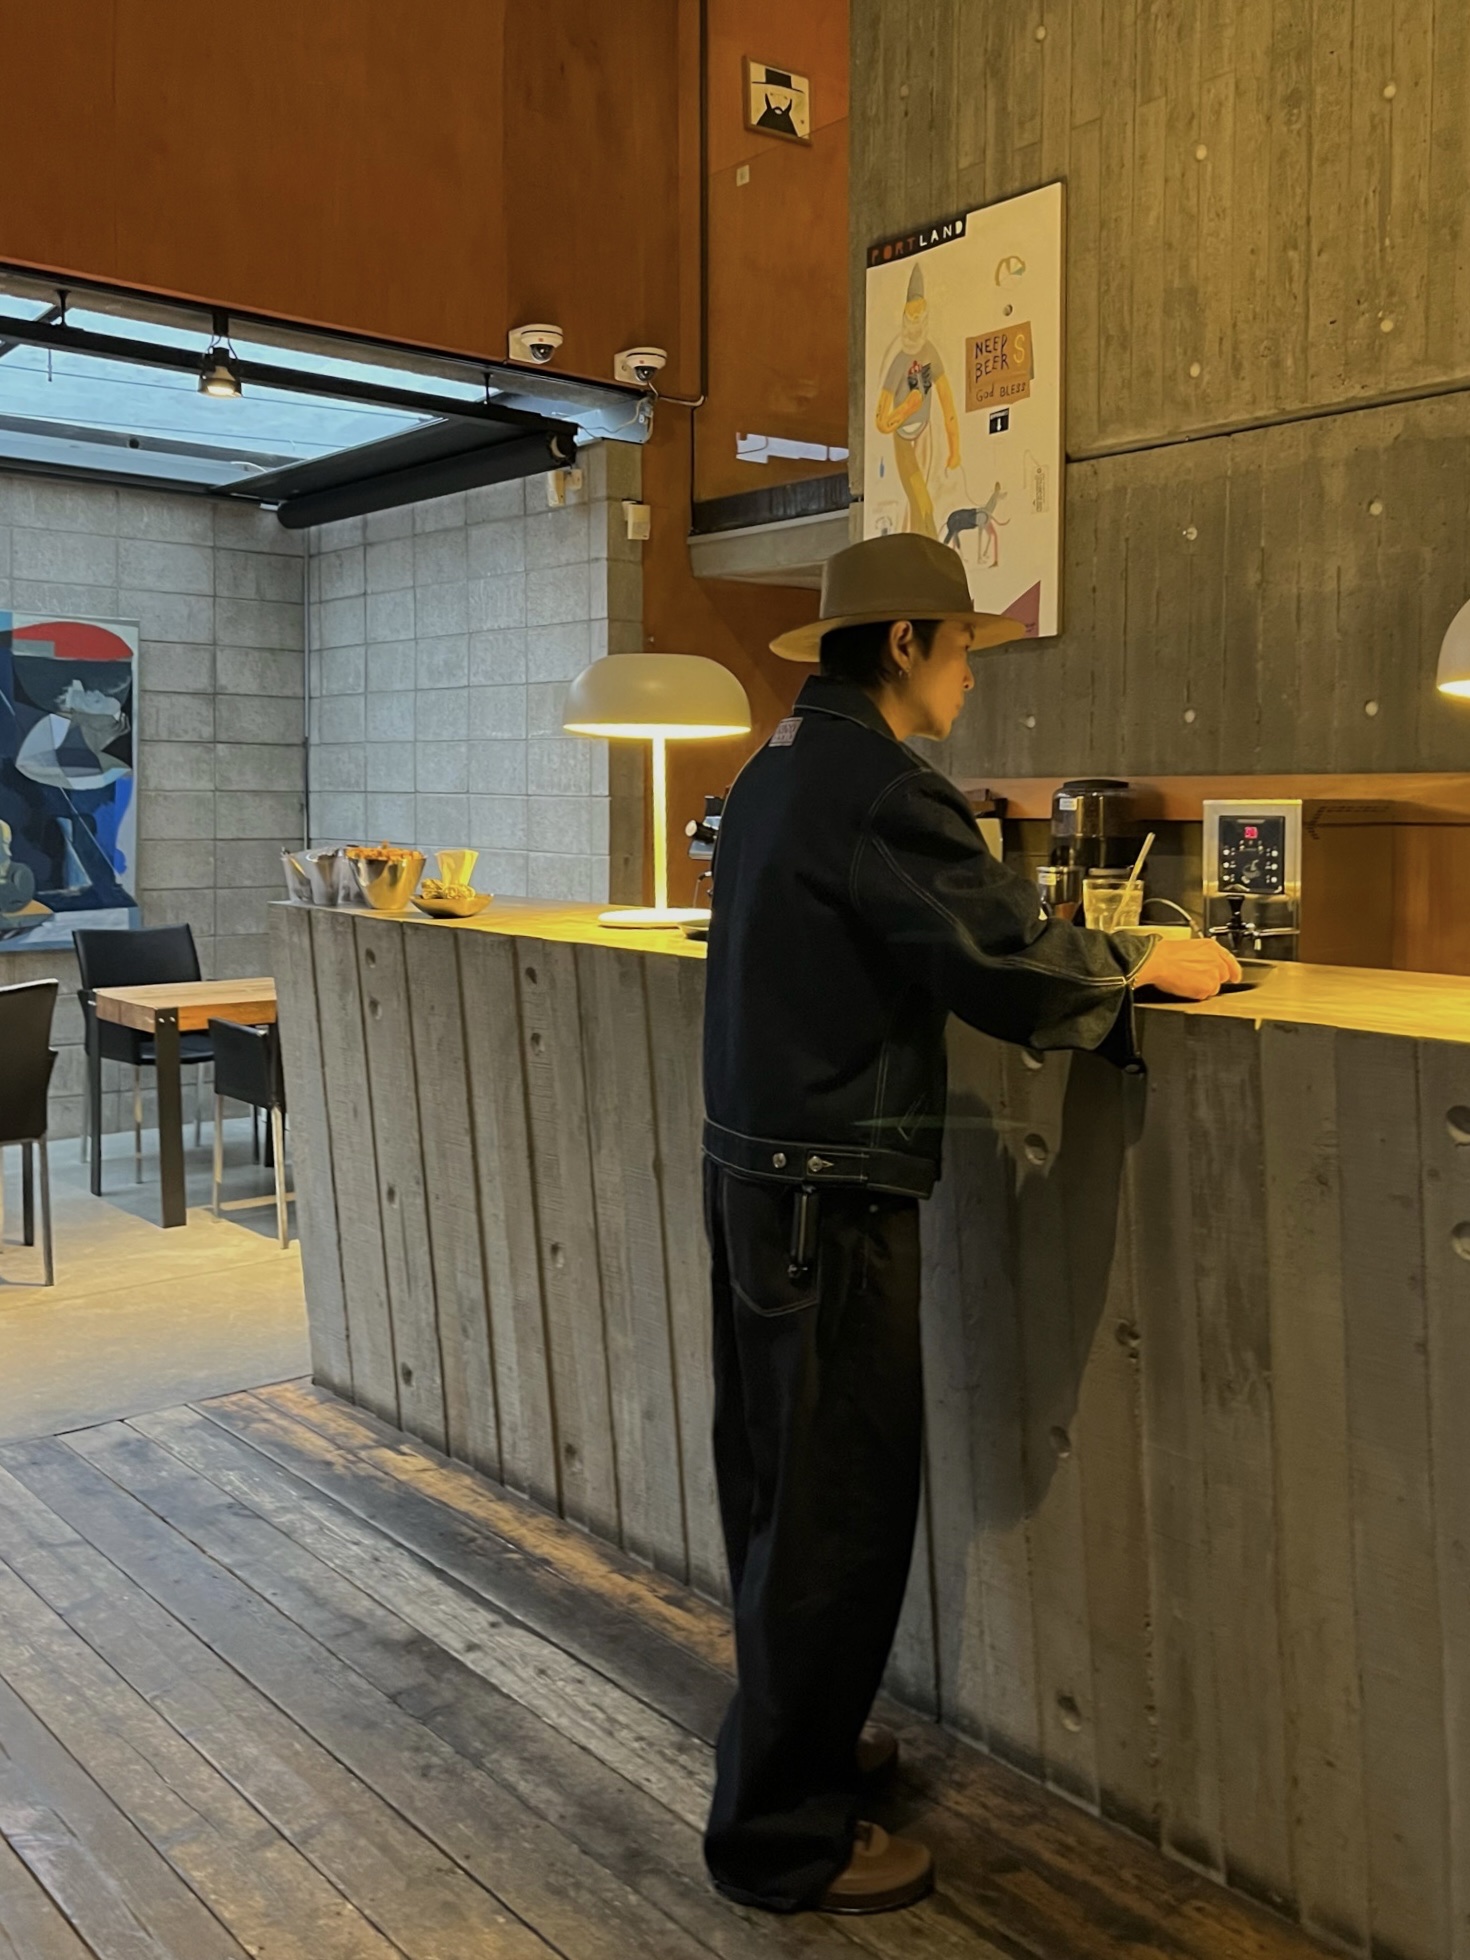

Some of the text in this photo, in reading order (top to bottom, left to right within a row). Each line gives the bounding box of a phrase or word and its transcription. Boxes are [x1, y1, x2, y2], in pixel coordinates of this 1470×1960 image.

[871, 220, 963, 265] PORTLAND
[975, 354, 1009, 383] BEER
[976, 382, 1026, 402] God BLESS
